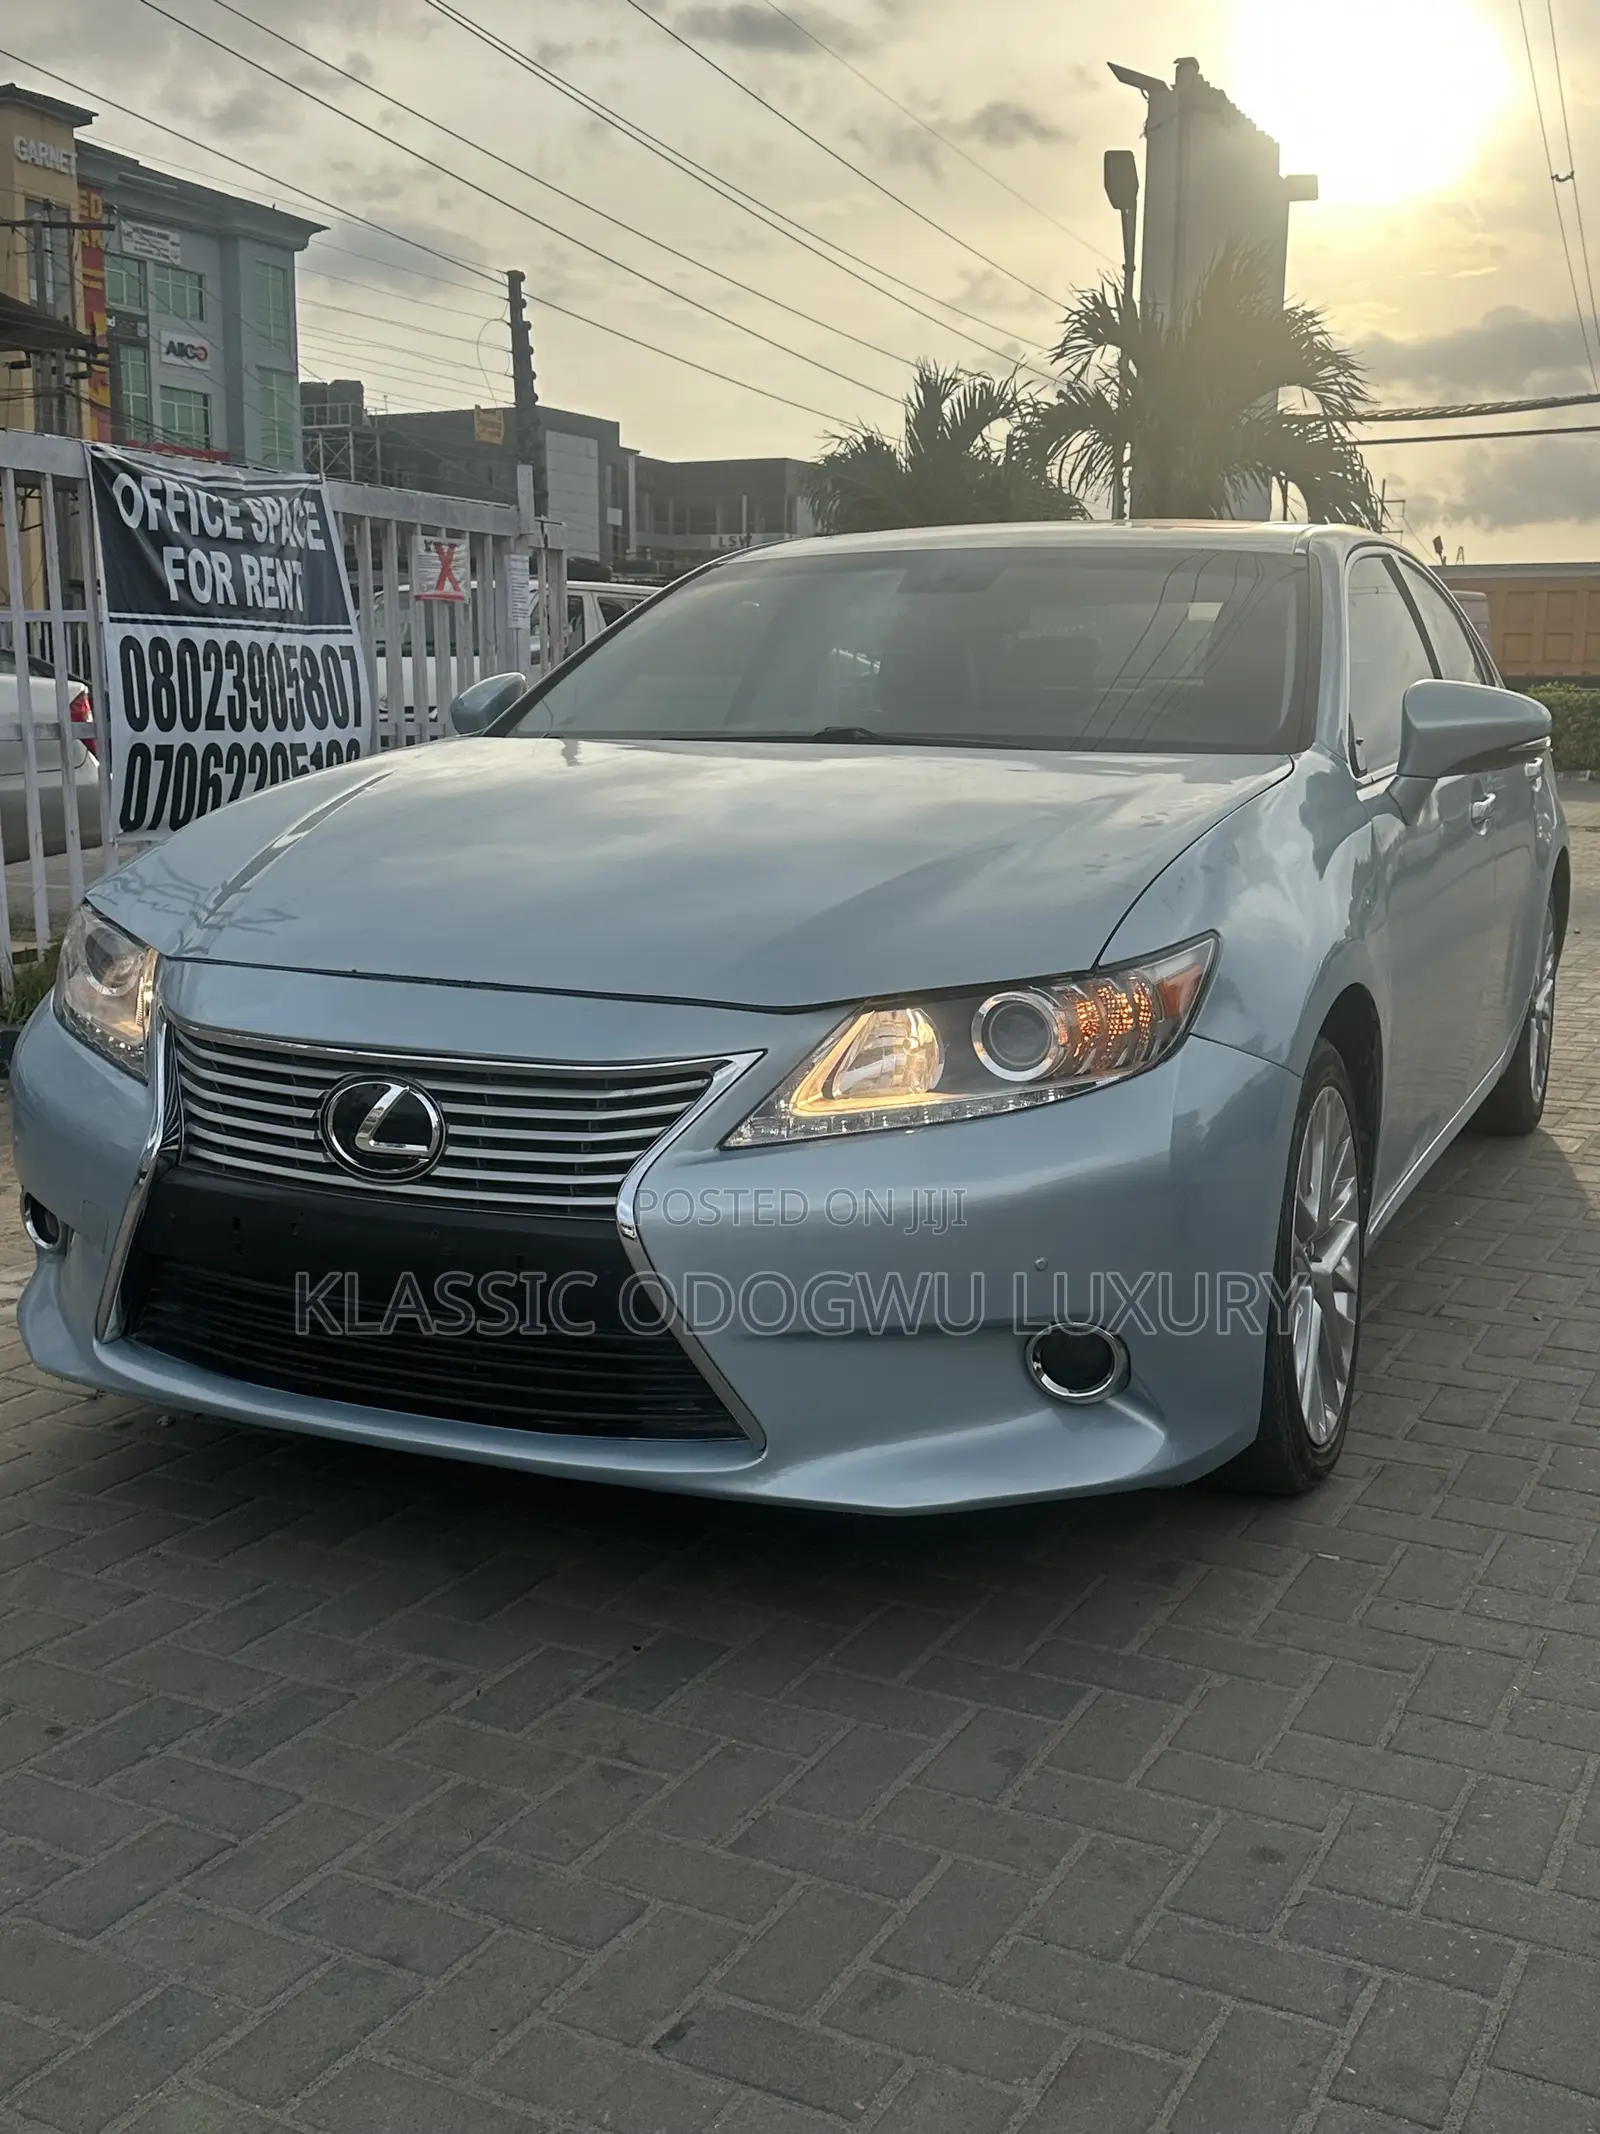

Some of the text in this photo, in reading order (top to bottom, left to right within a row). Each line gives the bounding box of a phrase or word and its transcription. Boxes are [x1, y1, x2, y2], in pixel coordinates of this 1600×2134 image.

[13, 135, 78, 176] GARNET
[112, 472, 326, 551] OFFICE SPACE
[163, 546, 304, 612] FOR RENT
[120, 635, 362, 732] 08023905807
